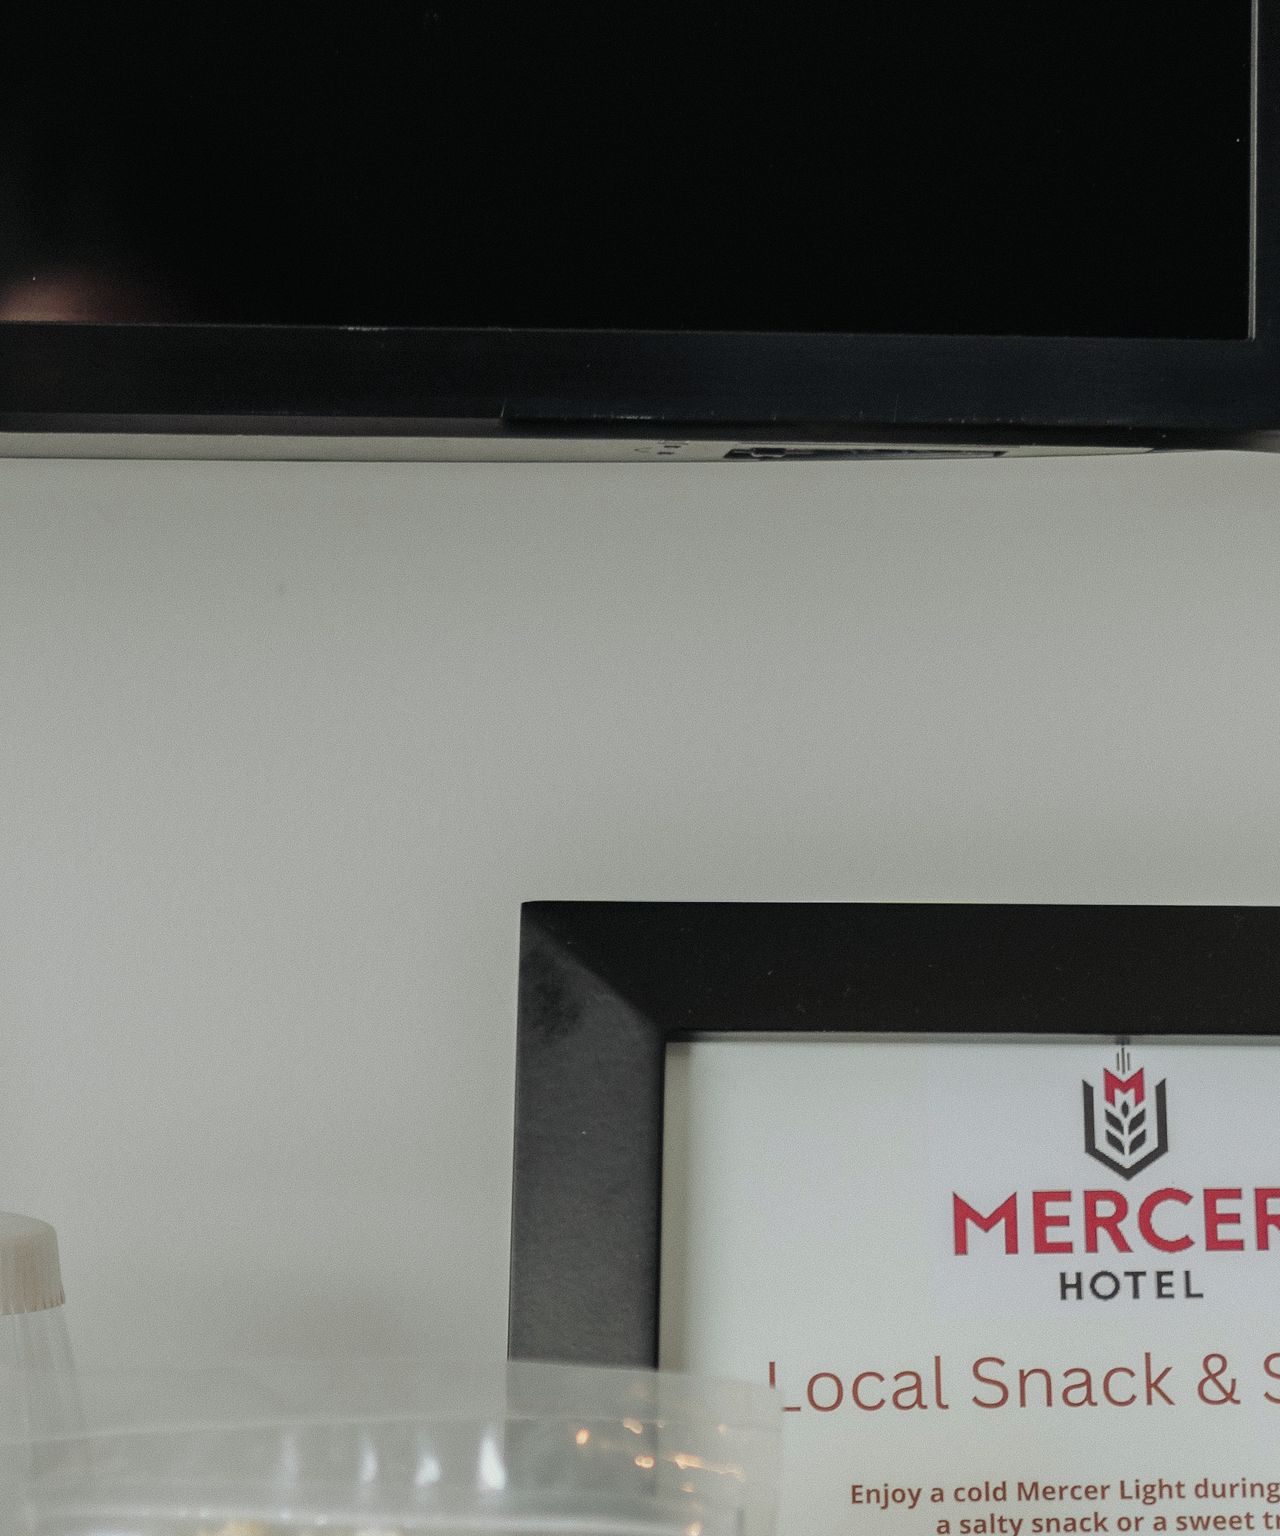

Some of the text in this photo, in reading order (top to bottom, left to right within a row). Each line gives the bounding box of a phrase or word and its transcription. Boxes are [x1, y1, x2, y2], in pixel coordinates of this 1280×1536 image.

[1060, 1270, 1204, 1301] HOTEL
[768, 1354, 950, 1413] Local
[971, 1351, 1176, 1410] Snack
[1196, 1352, 1242, 1406] &
[850, 1482, 923, 1511] Enjoy
[929, 1486, 945, 1504] a
[953, 1480, 1008, 1503] cold
[1016, 1480, 1111, 1502] Mercer
[1119, 1477, 1187, 1507] Light
[935, 1518, 951, 1536] a
[1031, 1510, 1109, 1535] snack
[1116, 1515, 1145, 1533] or
[1152, 1515, 1168, 1533] a
[1175, 1511, 1256, 1532] sweet
